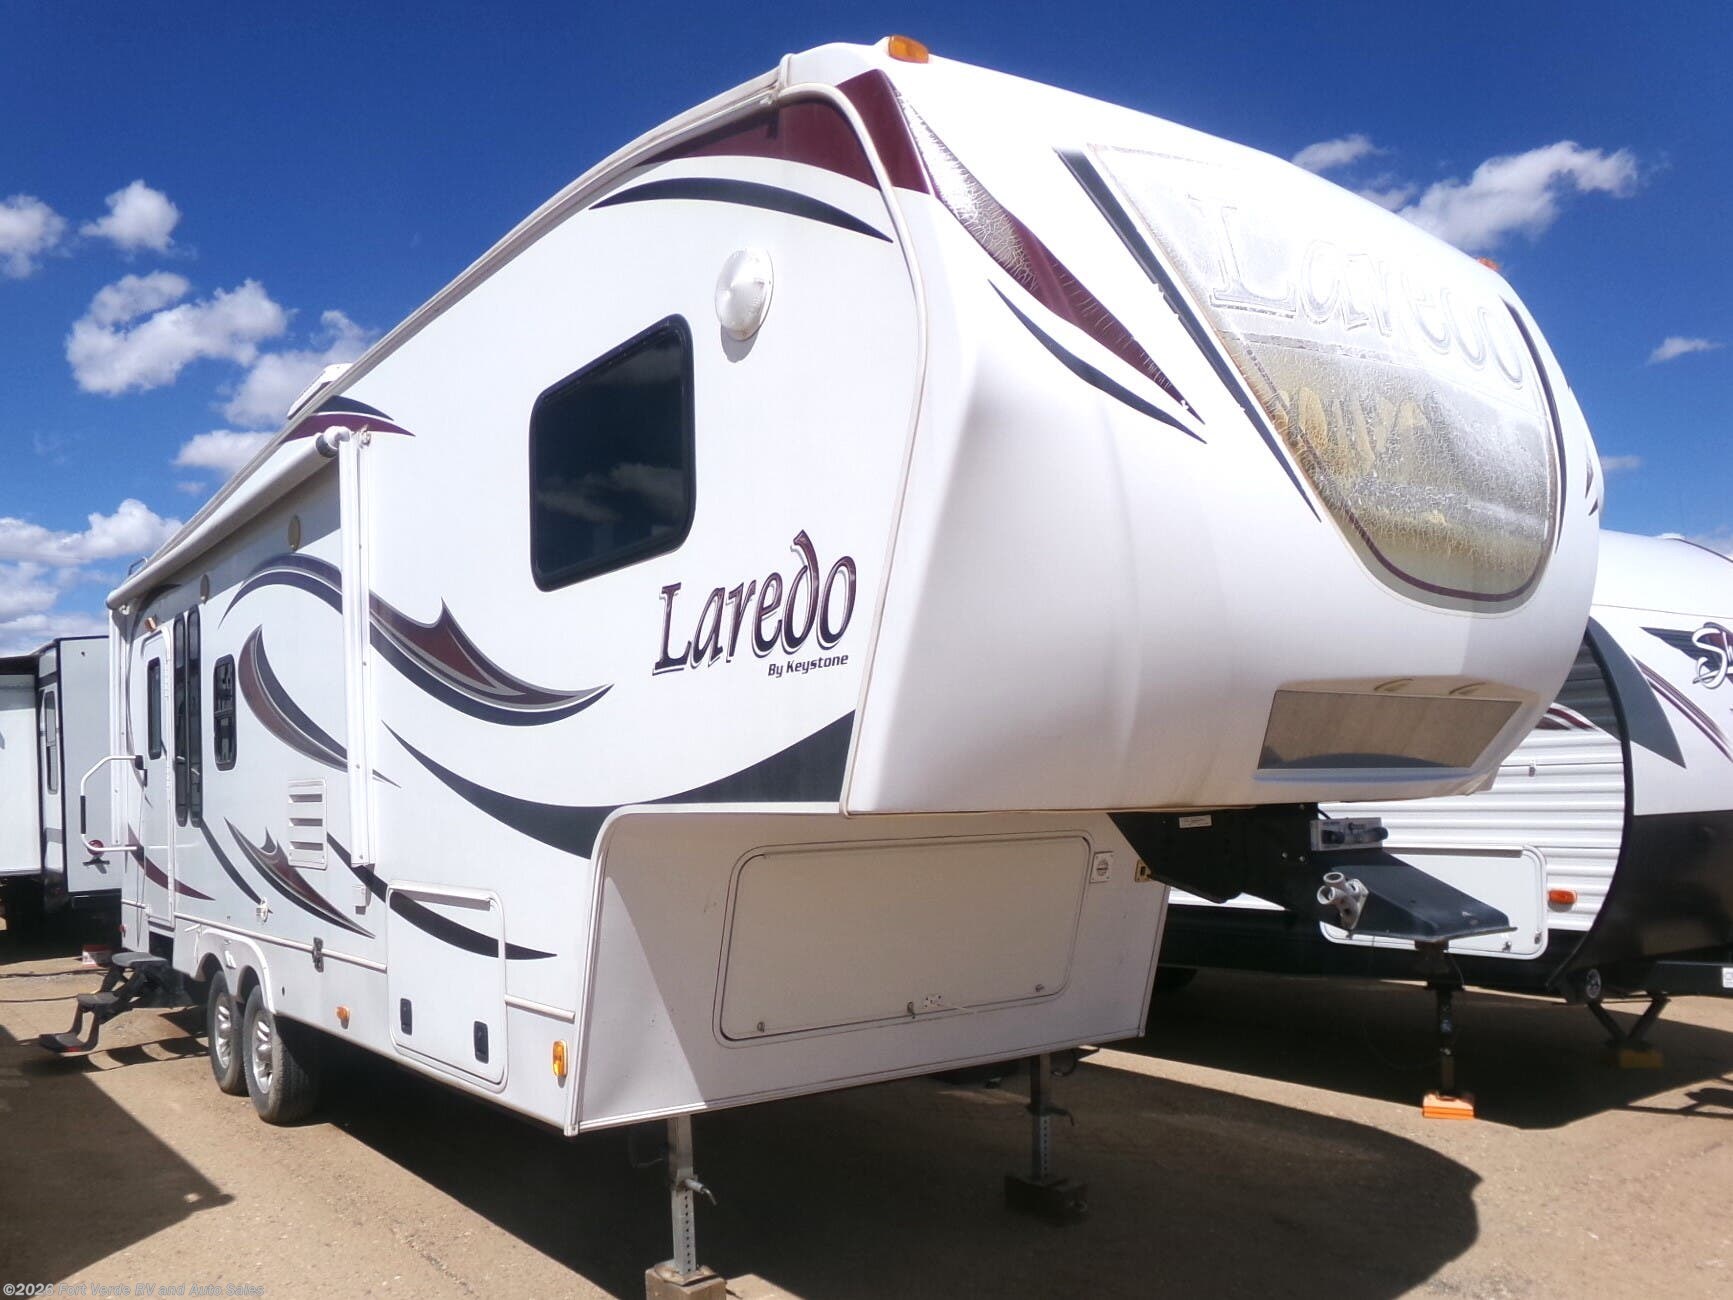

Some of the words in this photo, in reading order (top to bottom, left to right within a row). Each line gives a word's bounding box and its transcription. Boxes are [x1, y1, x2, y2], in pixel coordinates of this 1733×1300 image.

[652, 530, 857, 676] Laredo
[768, 663, 783, 678] By
[786, 655, 849, 674] Keystone
